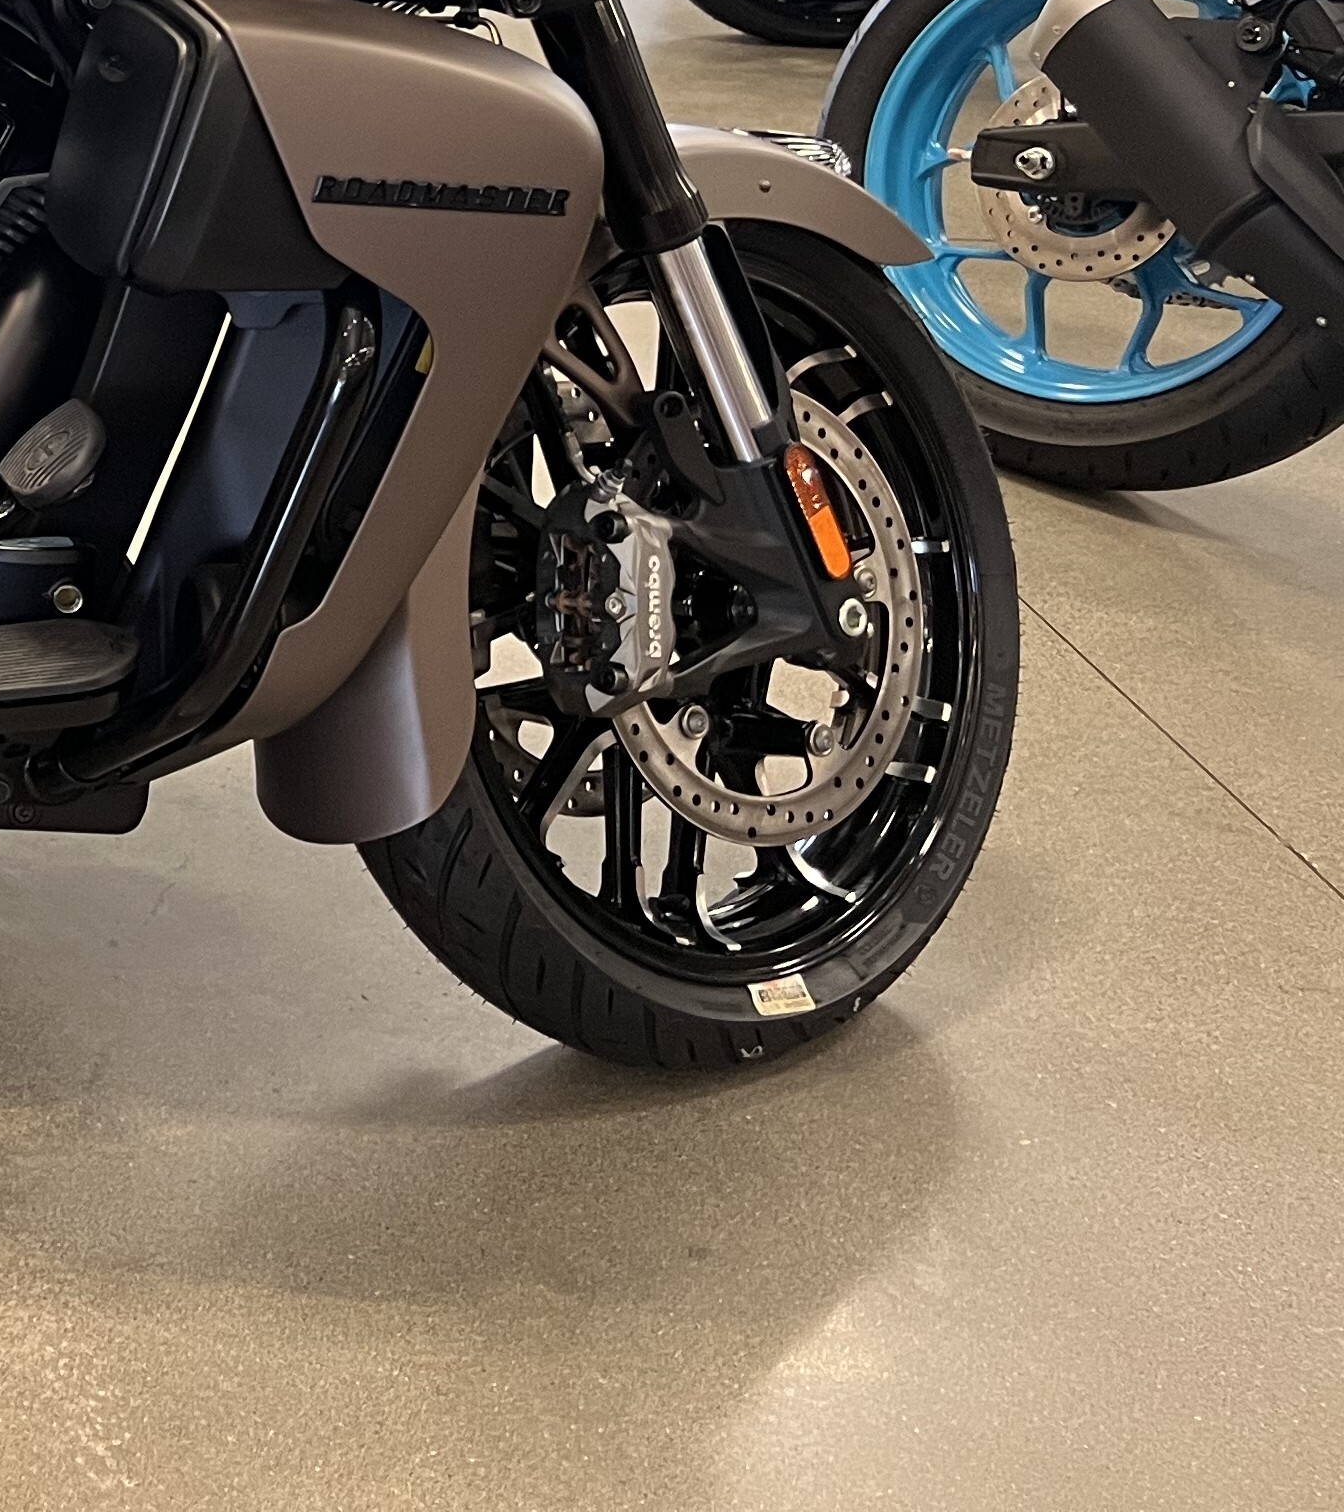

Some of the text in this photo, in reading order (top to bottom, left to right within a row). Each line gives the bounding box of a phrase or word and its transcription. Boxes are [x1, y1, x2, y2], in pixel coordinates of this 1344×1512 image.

[313, 175, 571, 216] ROADMASTER
[644, 554, 662, 658] brembo
[928, 682, 1008, 882] METZELER
